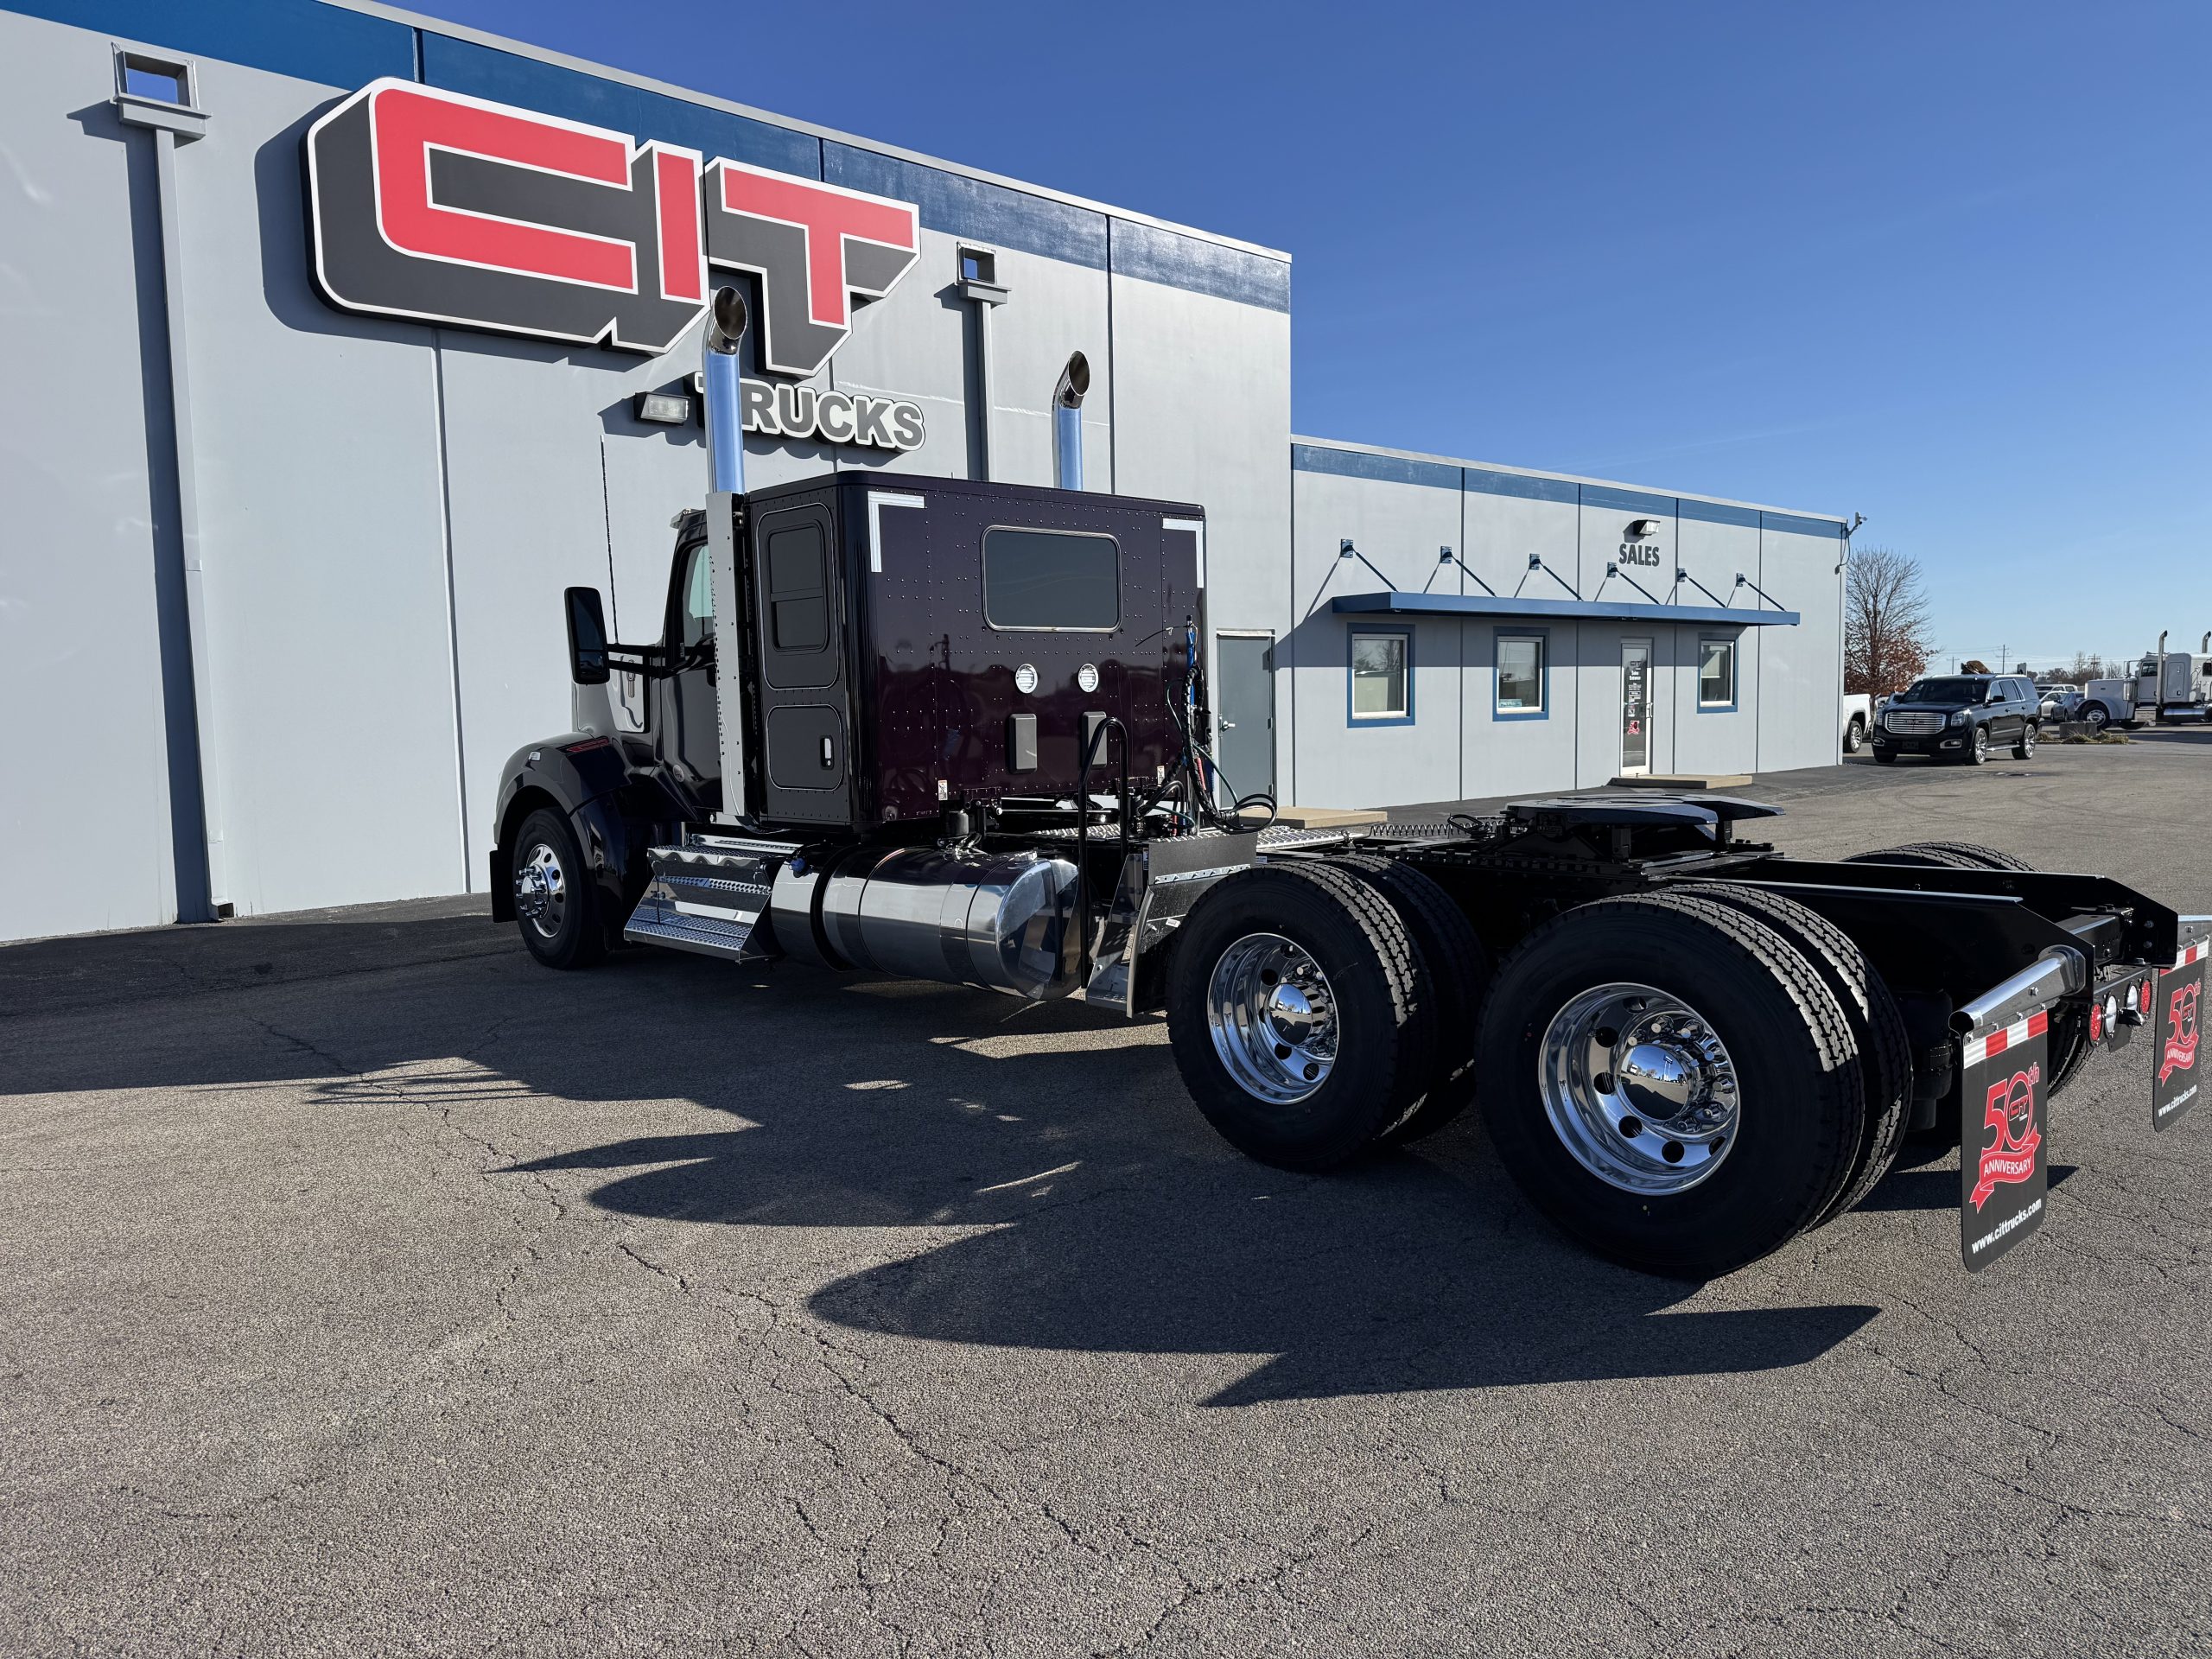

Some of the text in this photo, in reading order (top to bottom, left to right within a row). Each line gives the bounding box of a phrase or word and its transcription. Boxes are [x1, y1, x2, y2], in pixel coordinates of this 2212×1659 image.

[370, 78, 919, 333] CIT
[695, 372, 925, 450] RUCKS
[1618, 543, 1660, 567] SALES
[2158, 1084, 2197, 1117] www.cittrucks.com
[1983, 1155, 2031, 1176] ANNIVERSARY
[1971, 1198, 2042, 1255] www.cittrucks.com
